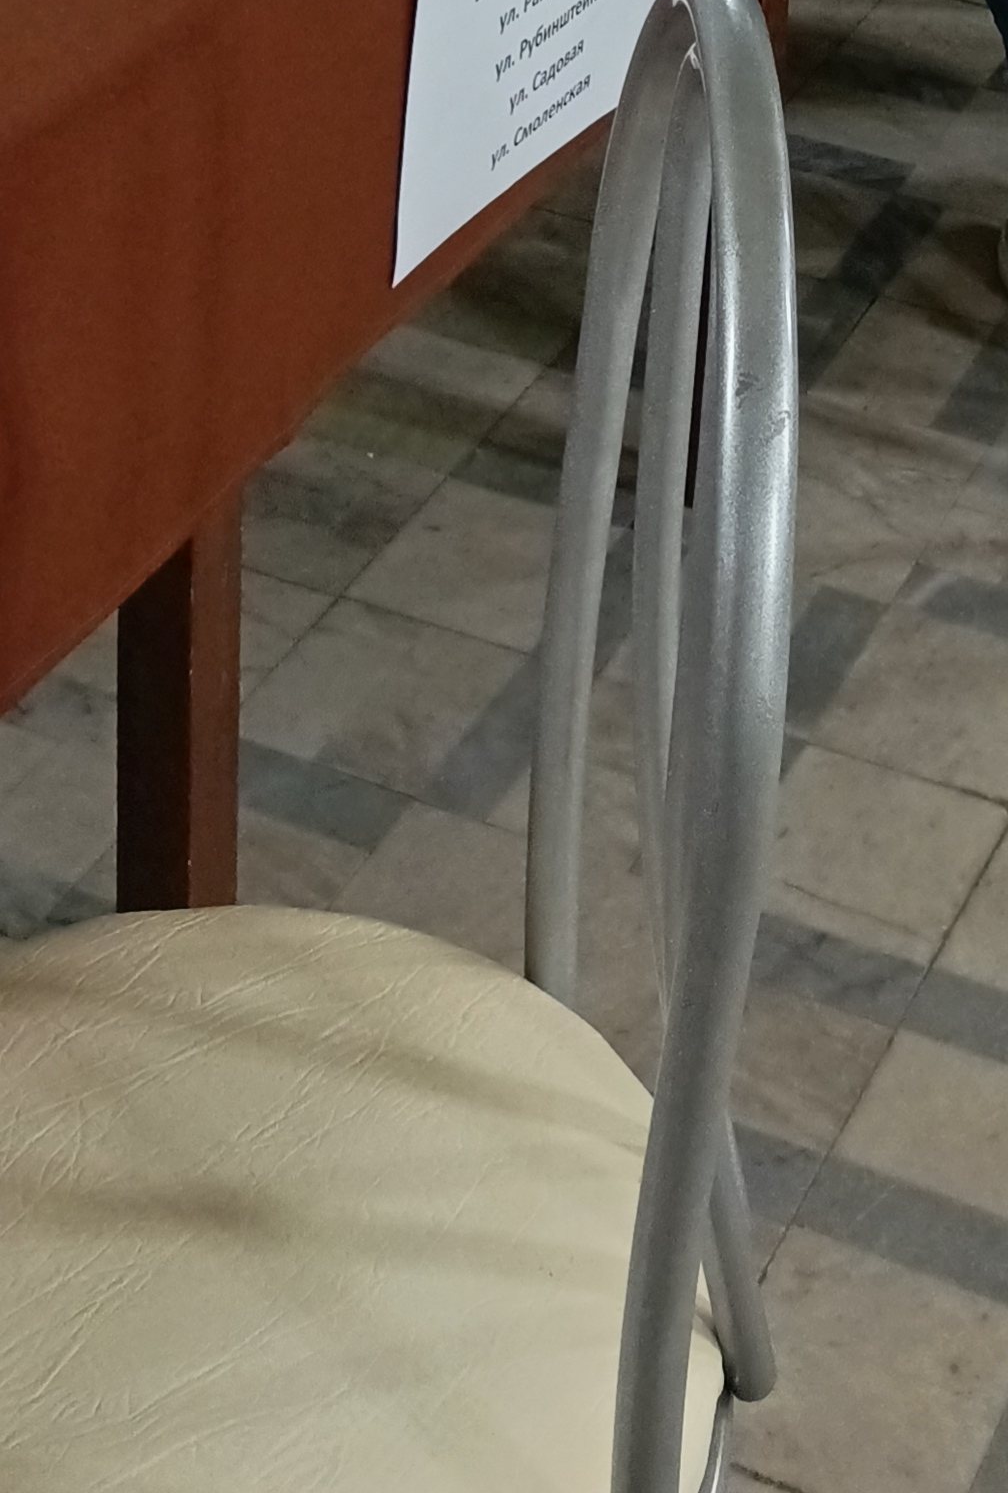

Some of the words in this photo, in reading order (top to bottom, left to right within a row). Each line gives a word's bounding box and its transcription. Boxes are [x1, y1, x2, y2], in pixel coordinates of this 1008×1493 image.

[500, 7, 519, 35] ул.
[495, 54, 515, 82] ул.
[509, 87, 528, 115] ул.
[532, 39, 584, 92] Садовая
[490, 143, 510, 171] ул.
[513, 74, 591, 146] Смоленская
